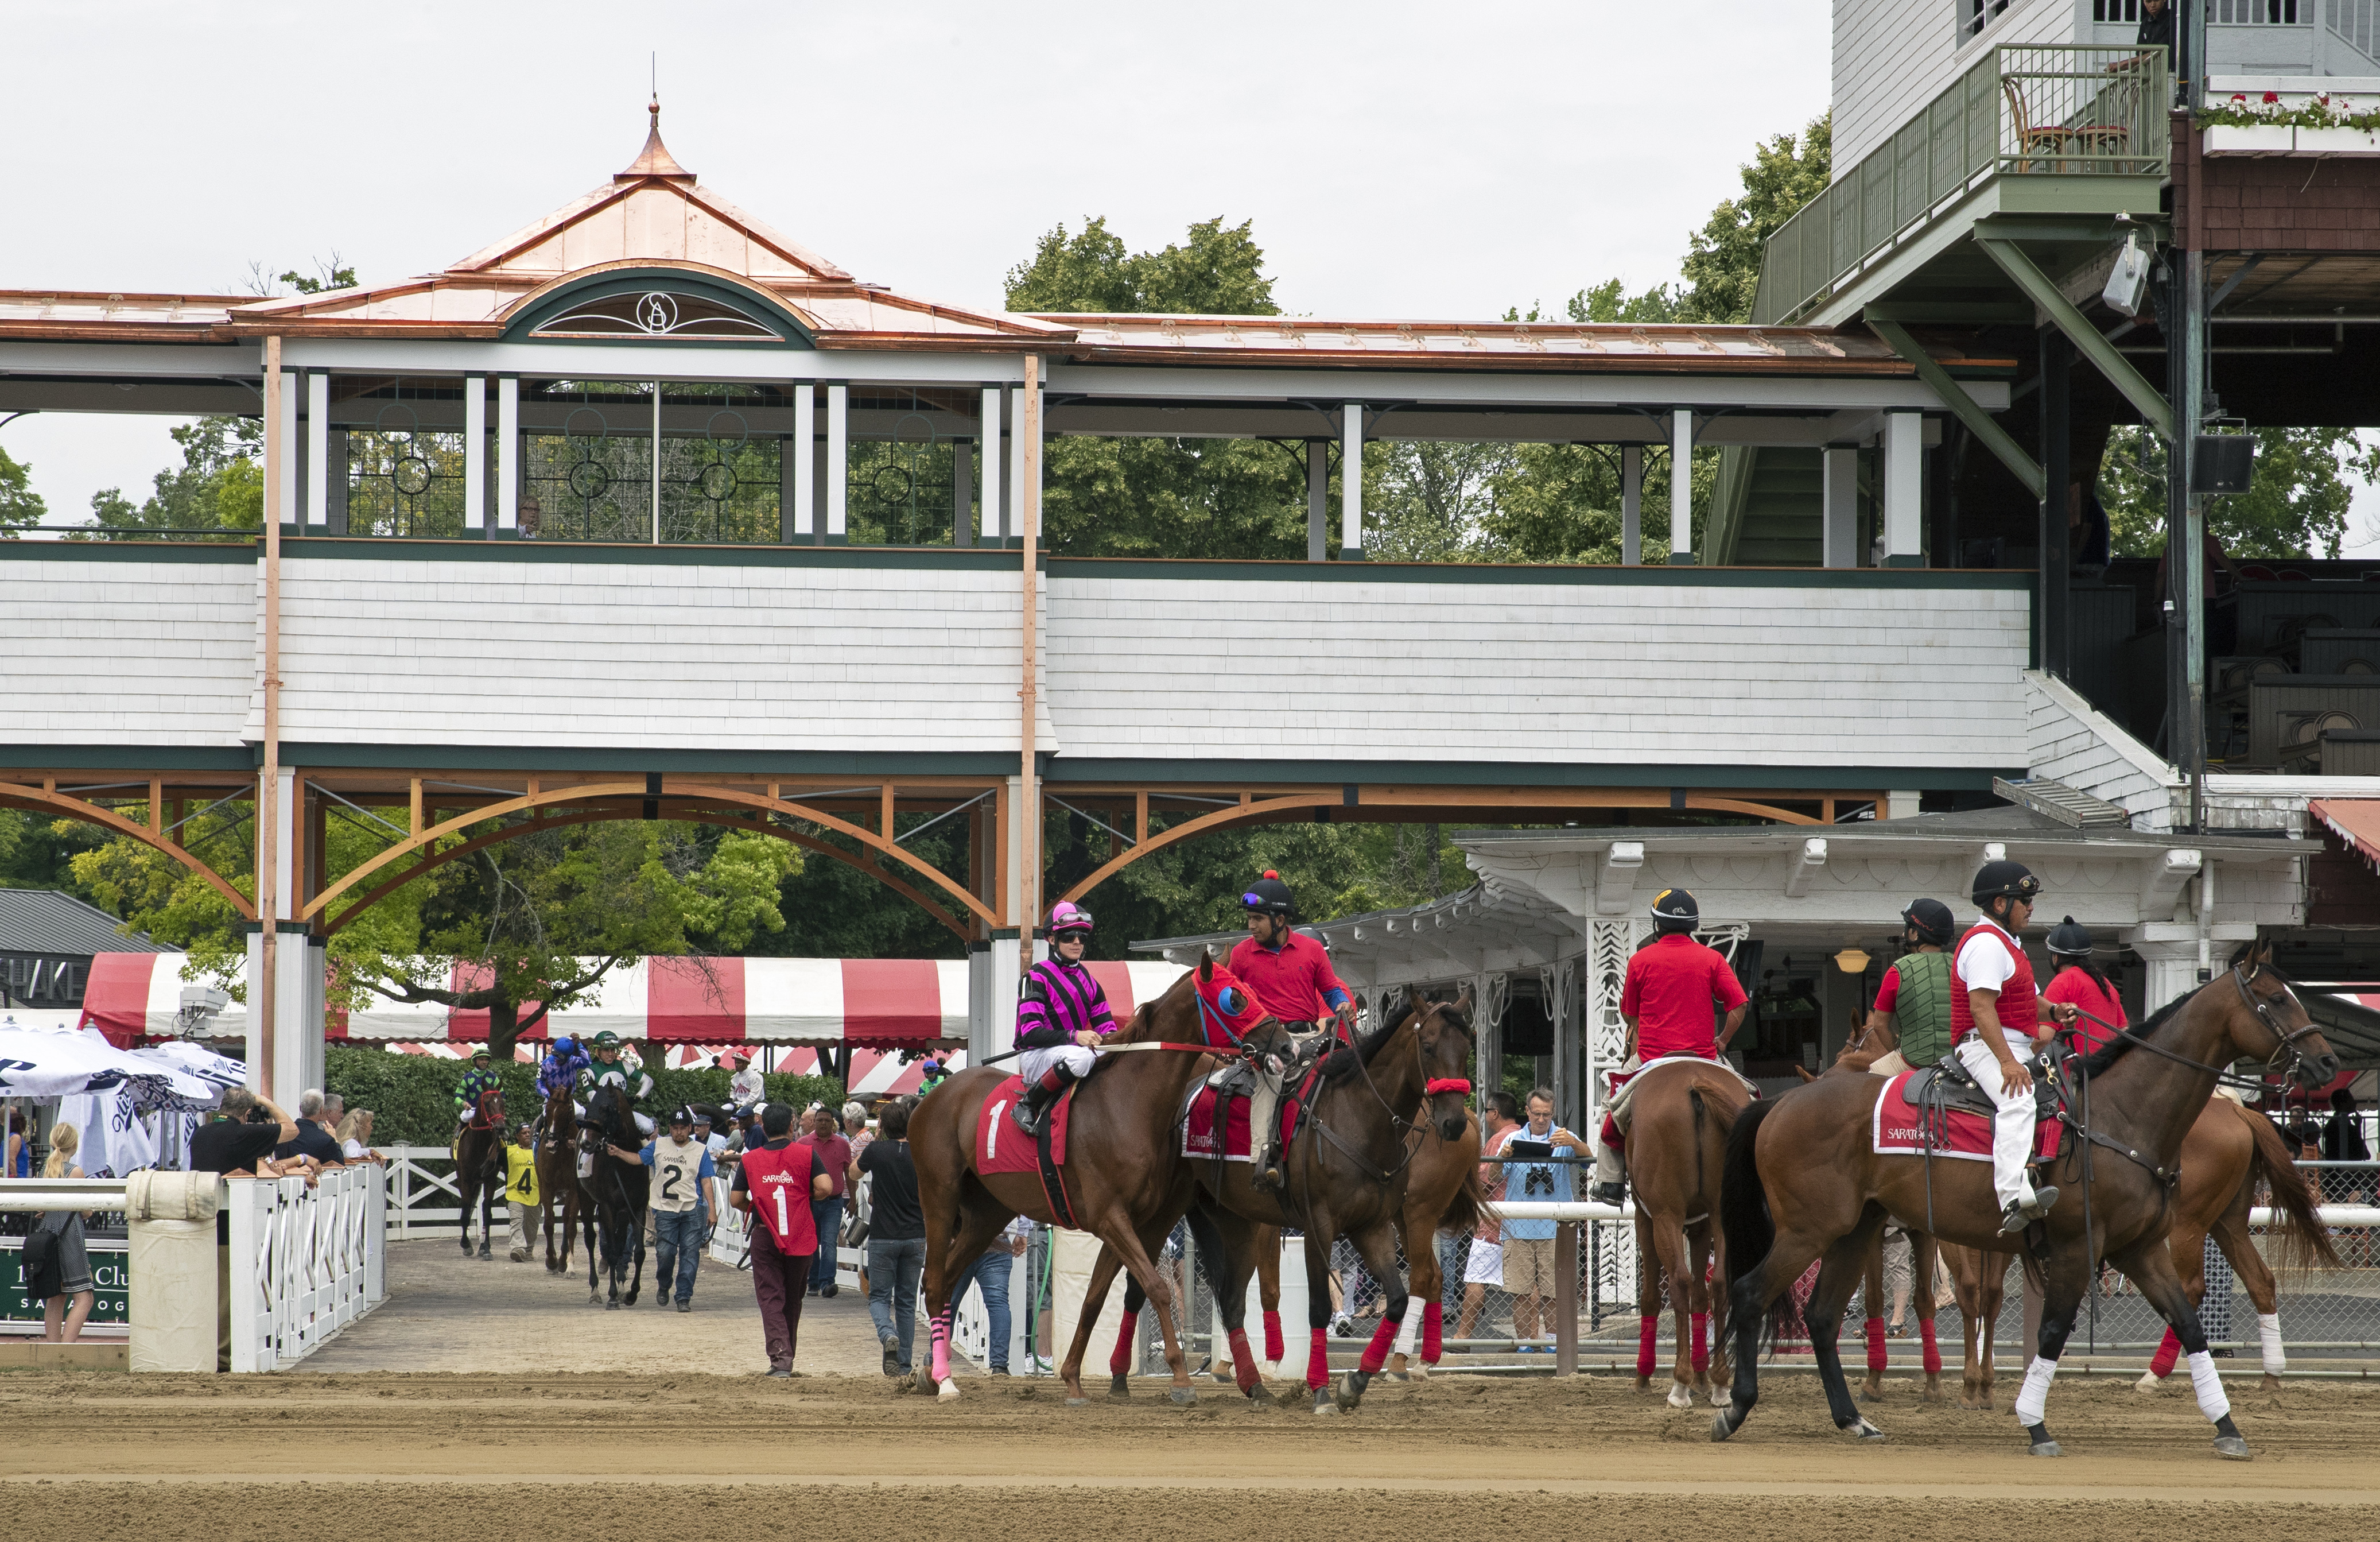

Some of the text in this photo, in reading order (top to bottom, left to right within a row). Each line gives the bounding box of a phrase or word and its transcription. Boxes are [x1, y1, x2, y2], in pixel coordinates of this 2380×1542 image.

[0, 958, 84, 1001] HAKE
[536, 1068, 542, 1079] 3
[581, 1073, 589, 1087] 2
[987, 1099, 1007, 1159] 1
[517, 1168, 532, 1195] 4
[662, 1164, 682, 1200] 2
[762, 1175, 794, 1184] SARATOGA
[772, 1185, 789, 1235] 1
